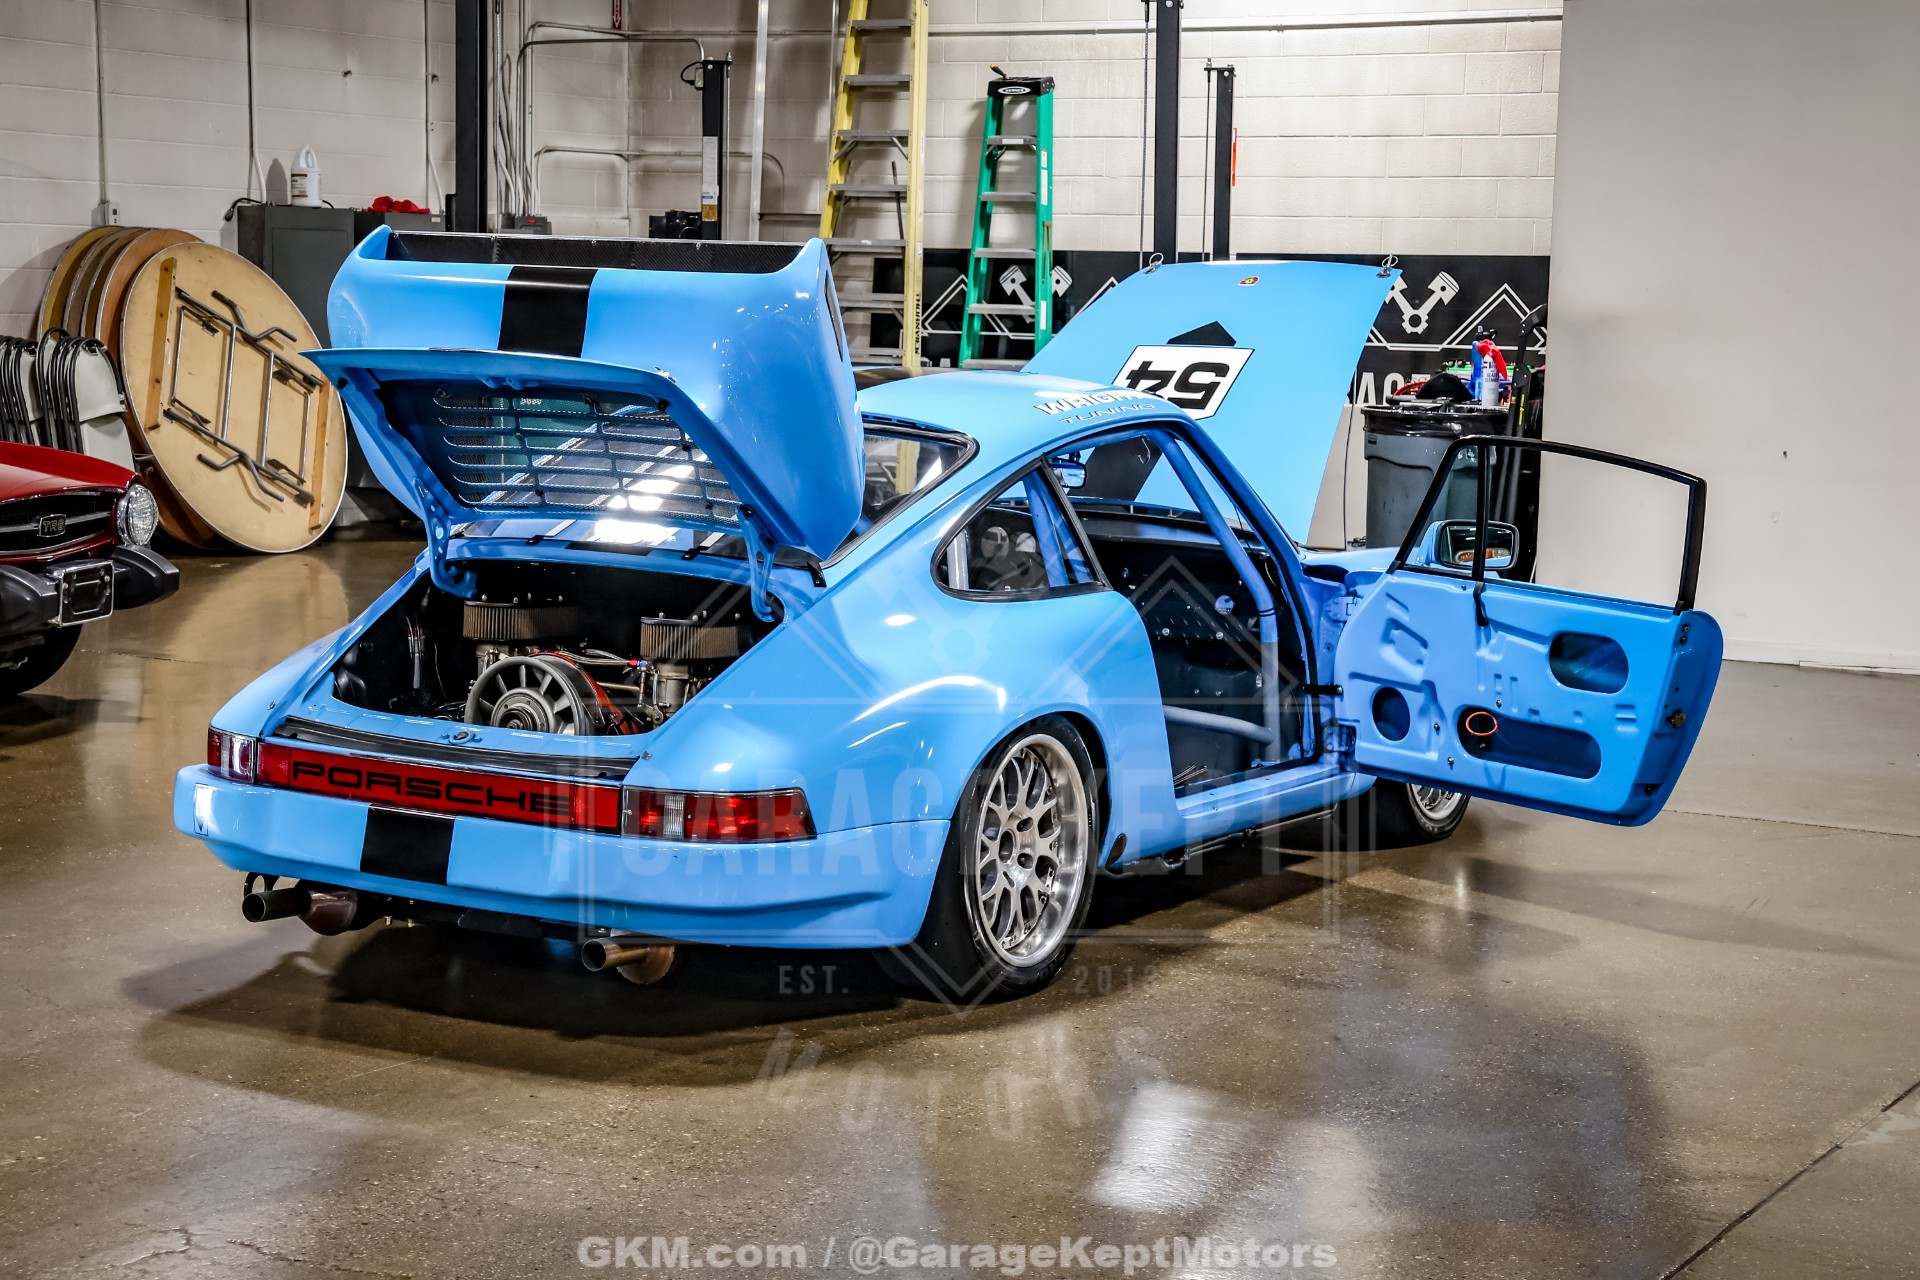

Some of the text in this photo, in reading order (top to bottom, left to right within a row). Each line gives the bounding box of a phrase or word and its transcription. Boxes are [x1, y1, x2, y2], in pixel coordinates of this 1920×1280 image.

[1125, 361, 1230, 410] 54
[1059, 403, 1155, 424] TUNING
[42, 519, 65, 533] TR6
[292, 760, 571, 816] PORSCHE
